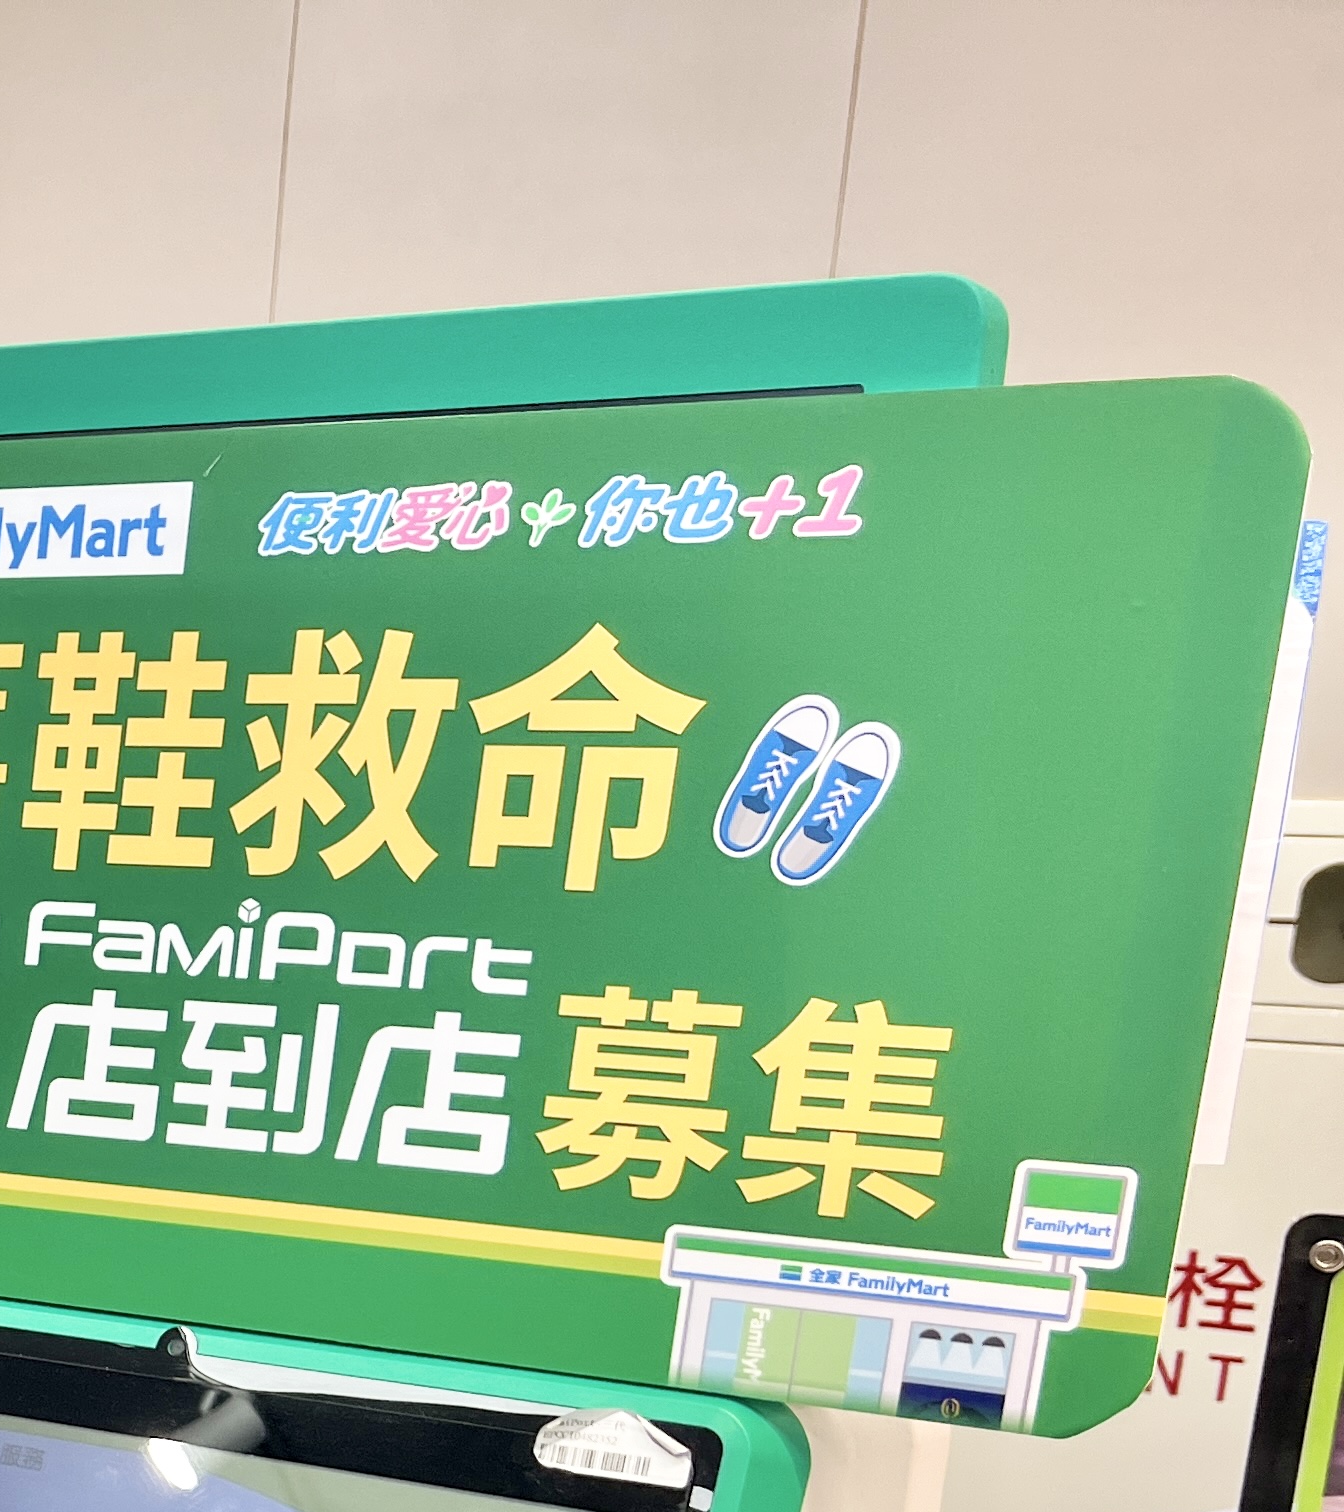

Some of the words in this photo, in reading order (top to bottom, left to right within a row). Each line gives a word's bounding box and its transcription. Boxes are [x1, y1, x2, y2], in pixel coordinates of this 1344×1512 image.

[259, 481, 512, 557] 便利愛心
[577, 464, 864, 548] 你也+1
[24, 897, 534, 996] FamiPort
[6, 989, 521, 1175] 店到店
[534, 985, 957, 1220] 募集
[1023, 1216, 1113, 1239] FamilyMart
[809, 1267, 841, 1287] 全家
[847, 1271, 951, 1298] FamilyMart
[1167, 1248, 1264, 1333] 栓
